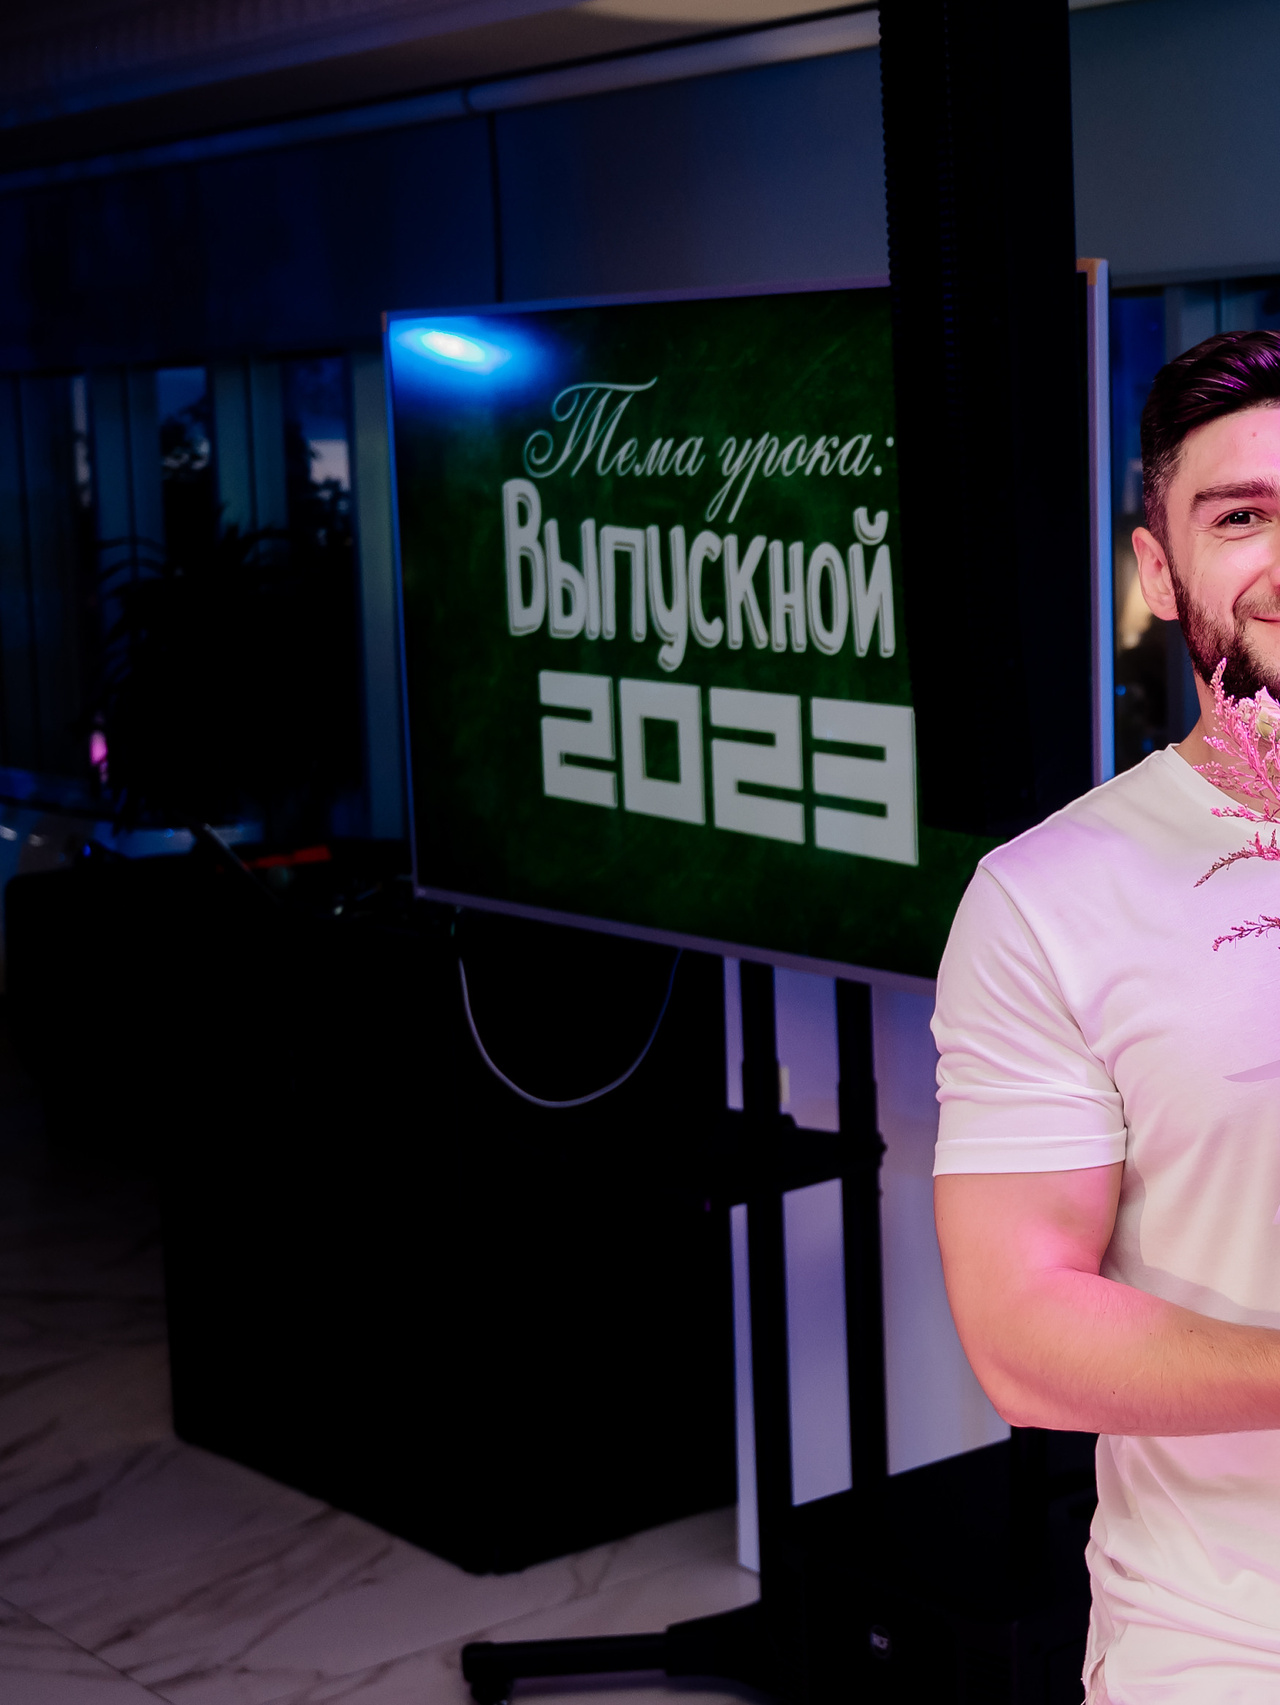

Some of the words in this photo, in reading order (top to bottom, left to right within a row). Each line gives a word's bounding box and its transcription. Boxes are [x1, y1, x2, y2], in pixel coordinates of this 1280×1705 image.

[524, 376, 704, 478] Тема
[705, 431, 894, 522] урока:
[538, 670, 918, 866] 2023
